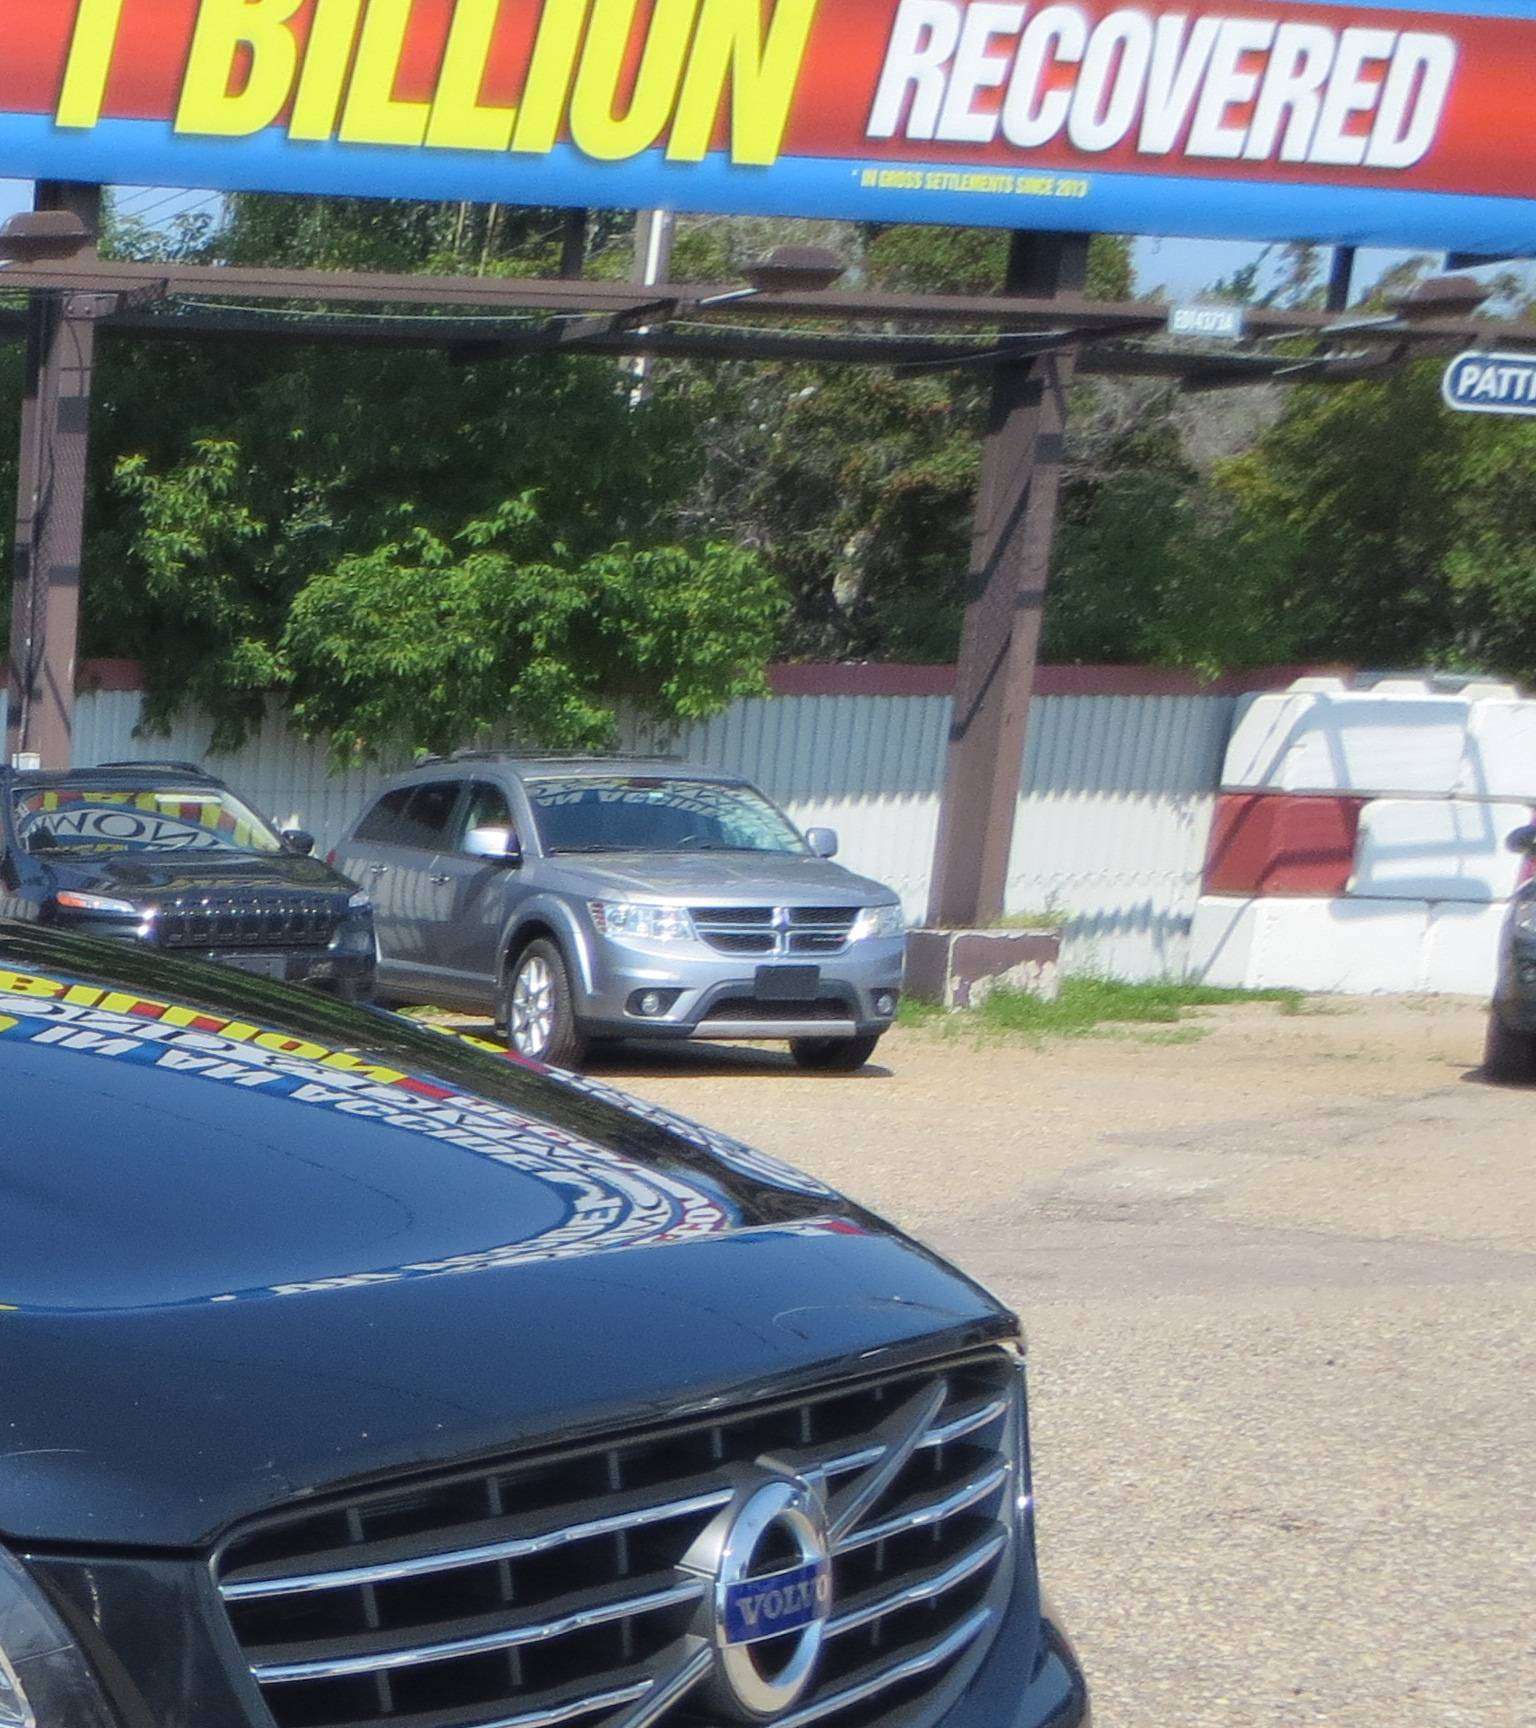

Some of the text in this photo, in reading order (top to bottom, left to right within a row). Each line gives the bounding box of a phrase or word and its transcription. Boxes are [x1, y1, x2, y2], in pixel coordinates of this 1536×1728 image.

[174, 0, 819, 166] BILLION
[866, 0, 1459, 168] RECOVERED
[736, 1573, 827, 1626] VOLVO
